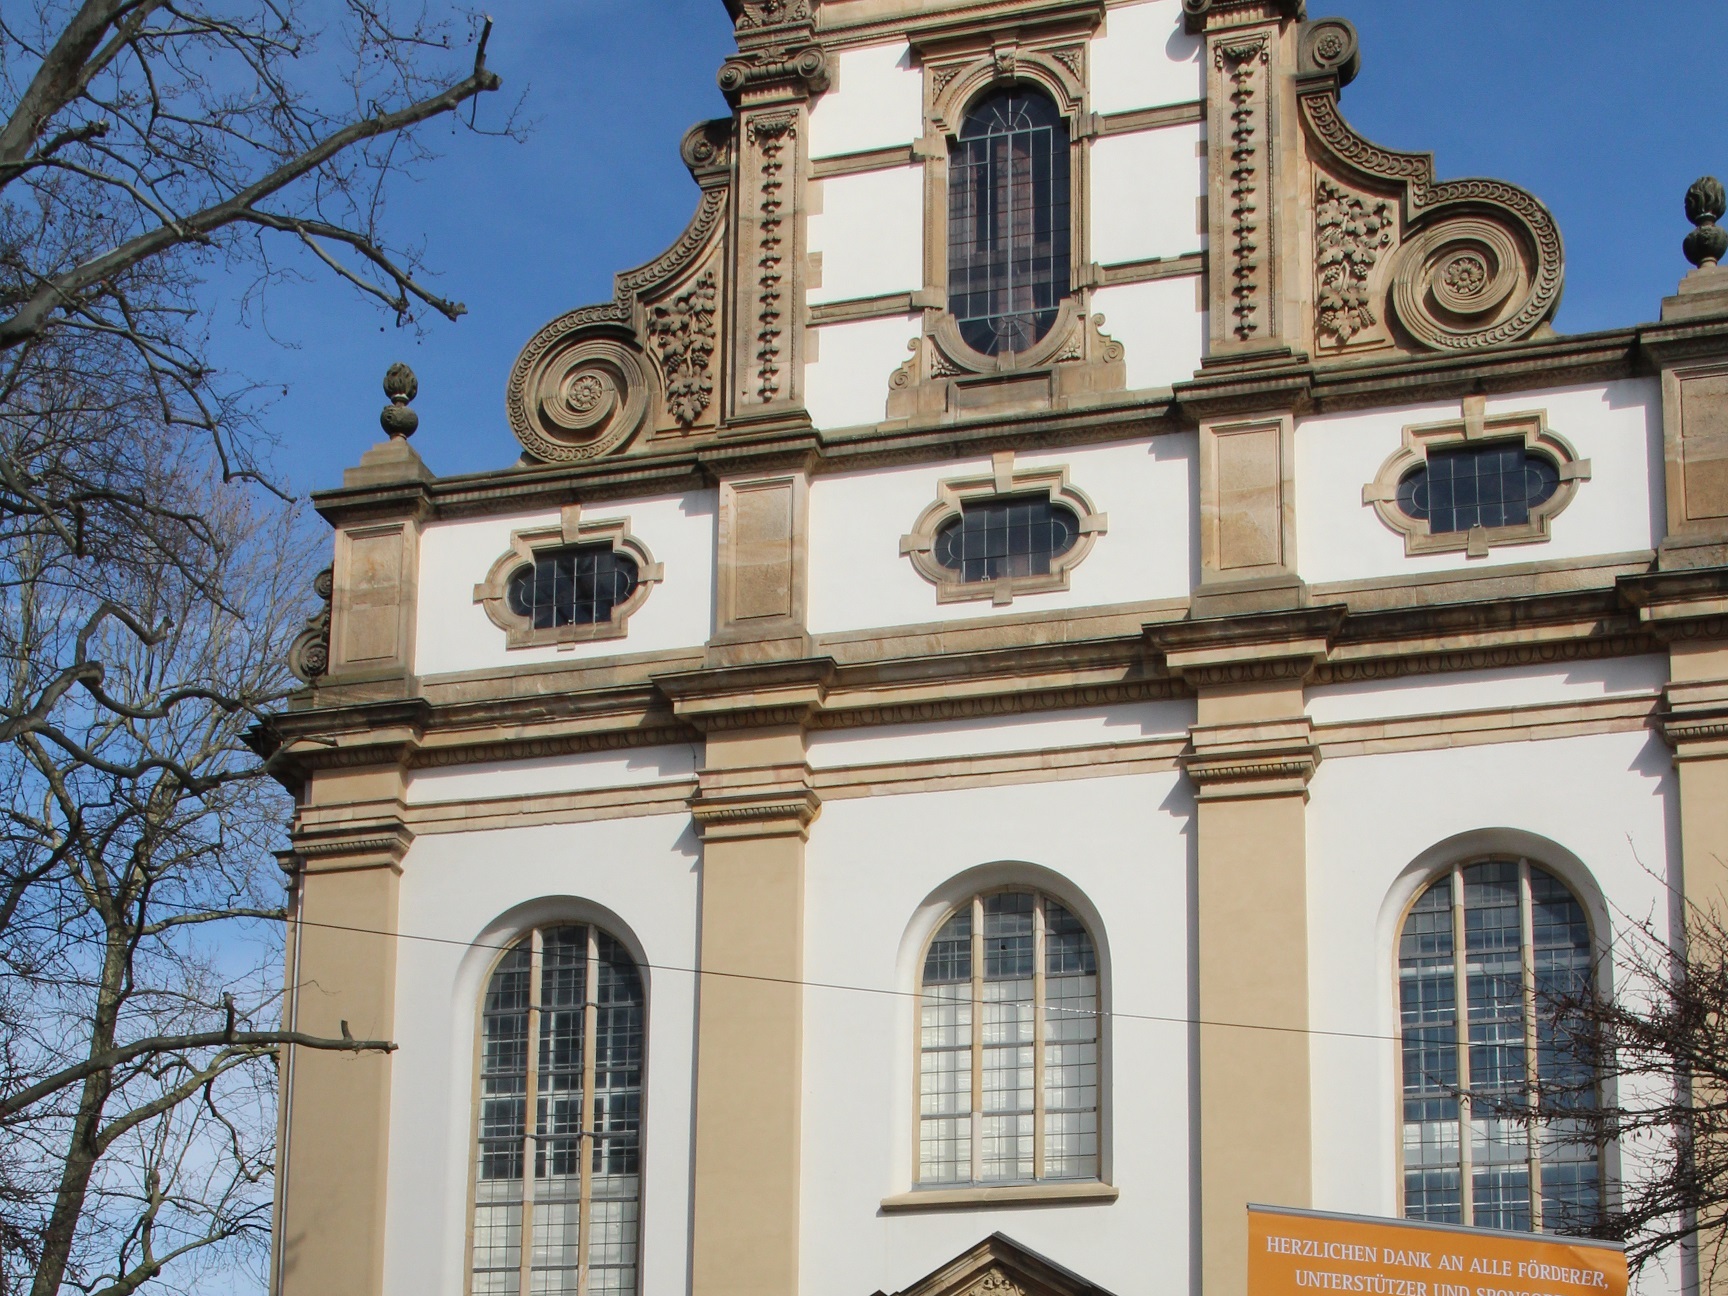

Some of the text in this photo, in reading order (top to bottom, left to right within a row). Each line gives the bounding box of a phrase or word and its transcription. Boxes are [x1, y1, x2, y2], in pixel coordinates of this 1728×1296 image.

[1267, 1236, 1609, 1290] HERZLICHEN DANK AN ALLE FÖRDERER,
